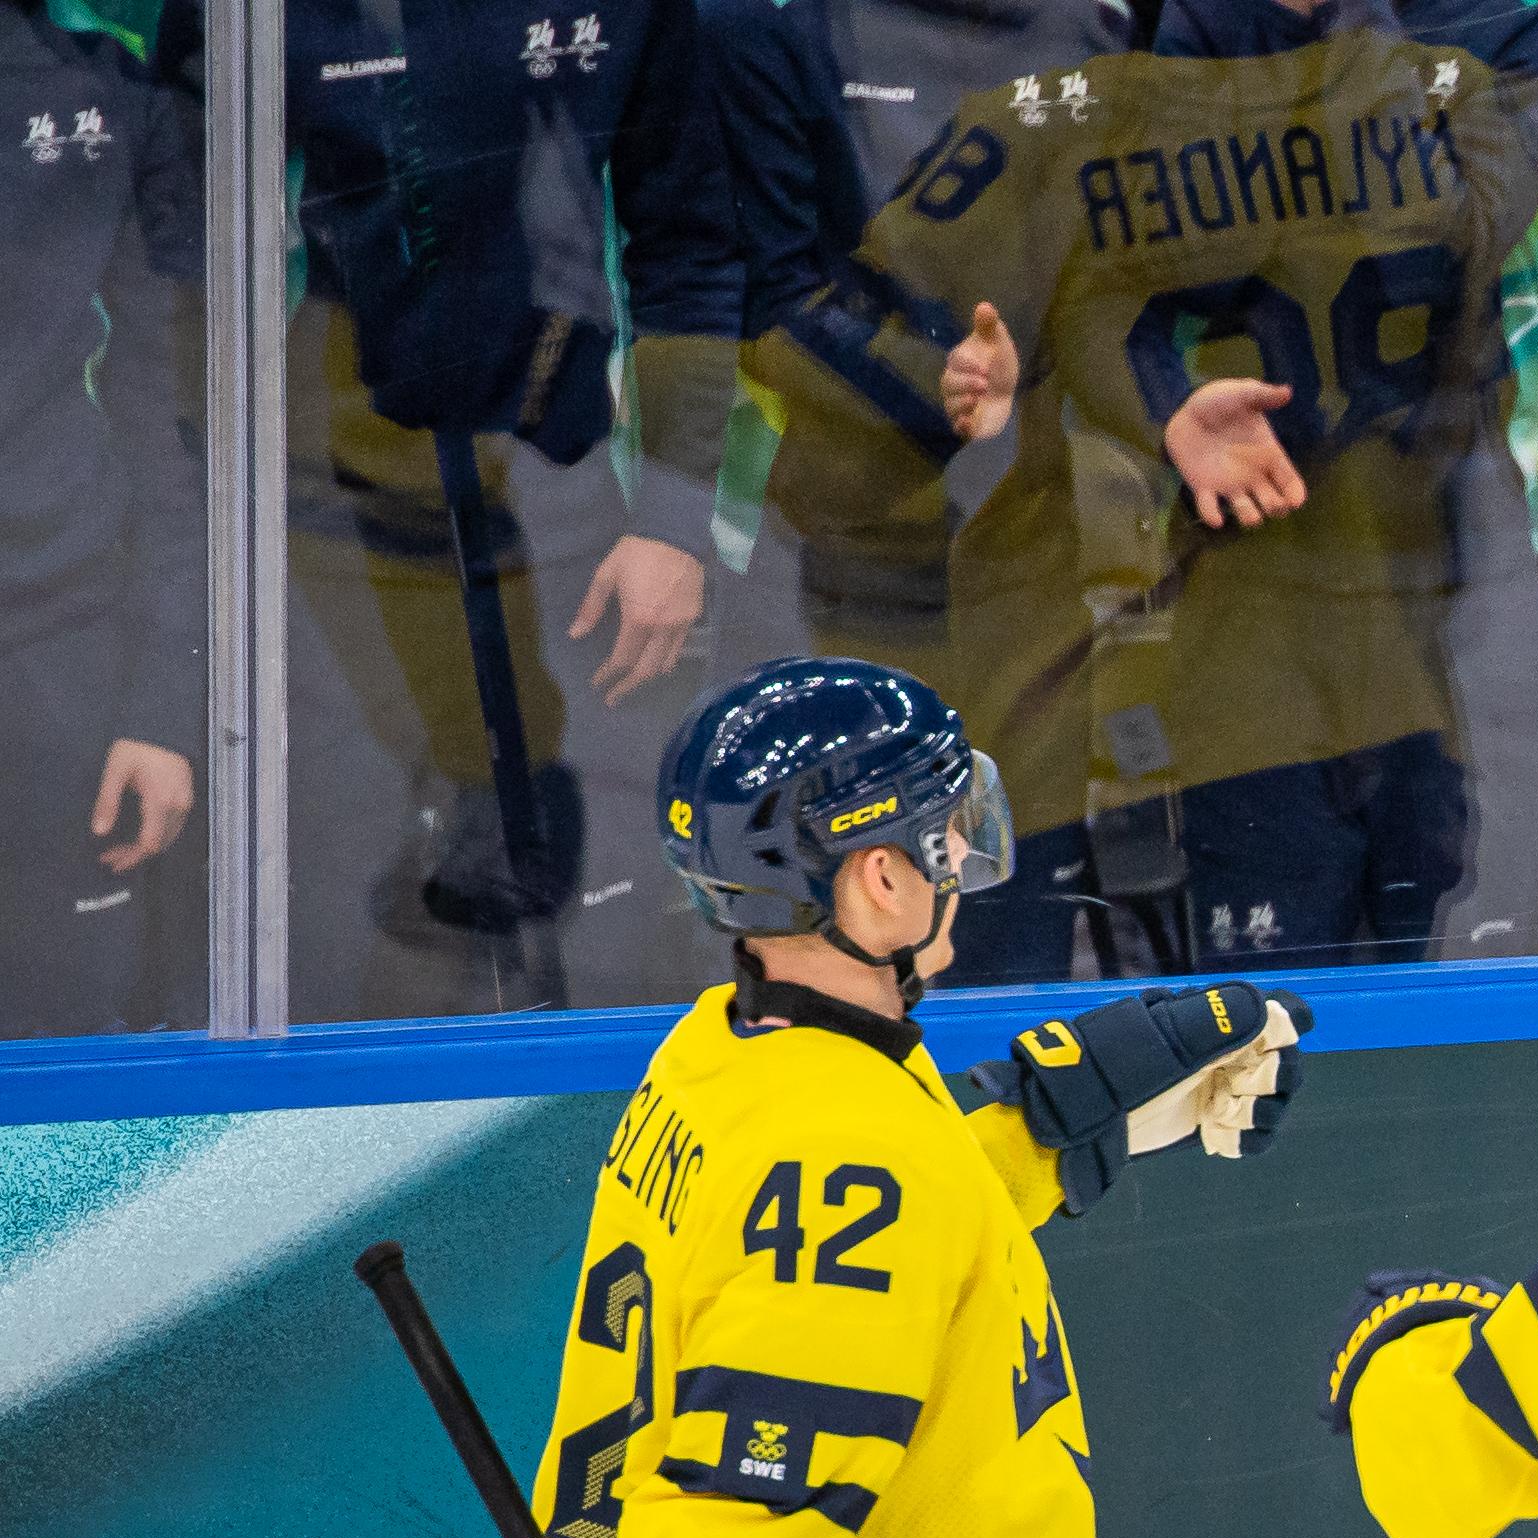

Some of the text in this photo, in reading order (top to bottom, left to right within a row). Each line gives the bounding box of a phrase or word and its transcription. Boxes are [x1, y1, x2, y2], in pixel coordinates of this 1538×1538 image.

[668, 799, 693, 839] 42
[830, 797, 897, 833] CCM
[742, 1161, 903, 1293] 42
[739, 1456, 787, 1481] SWE
